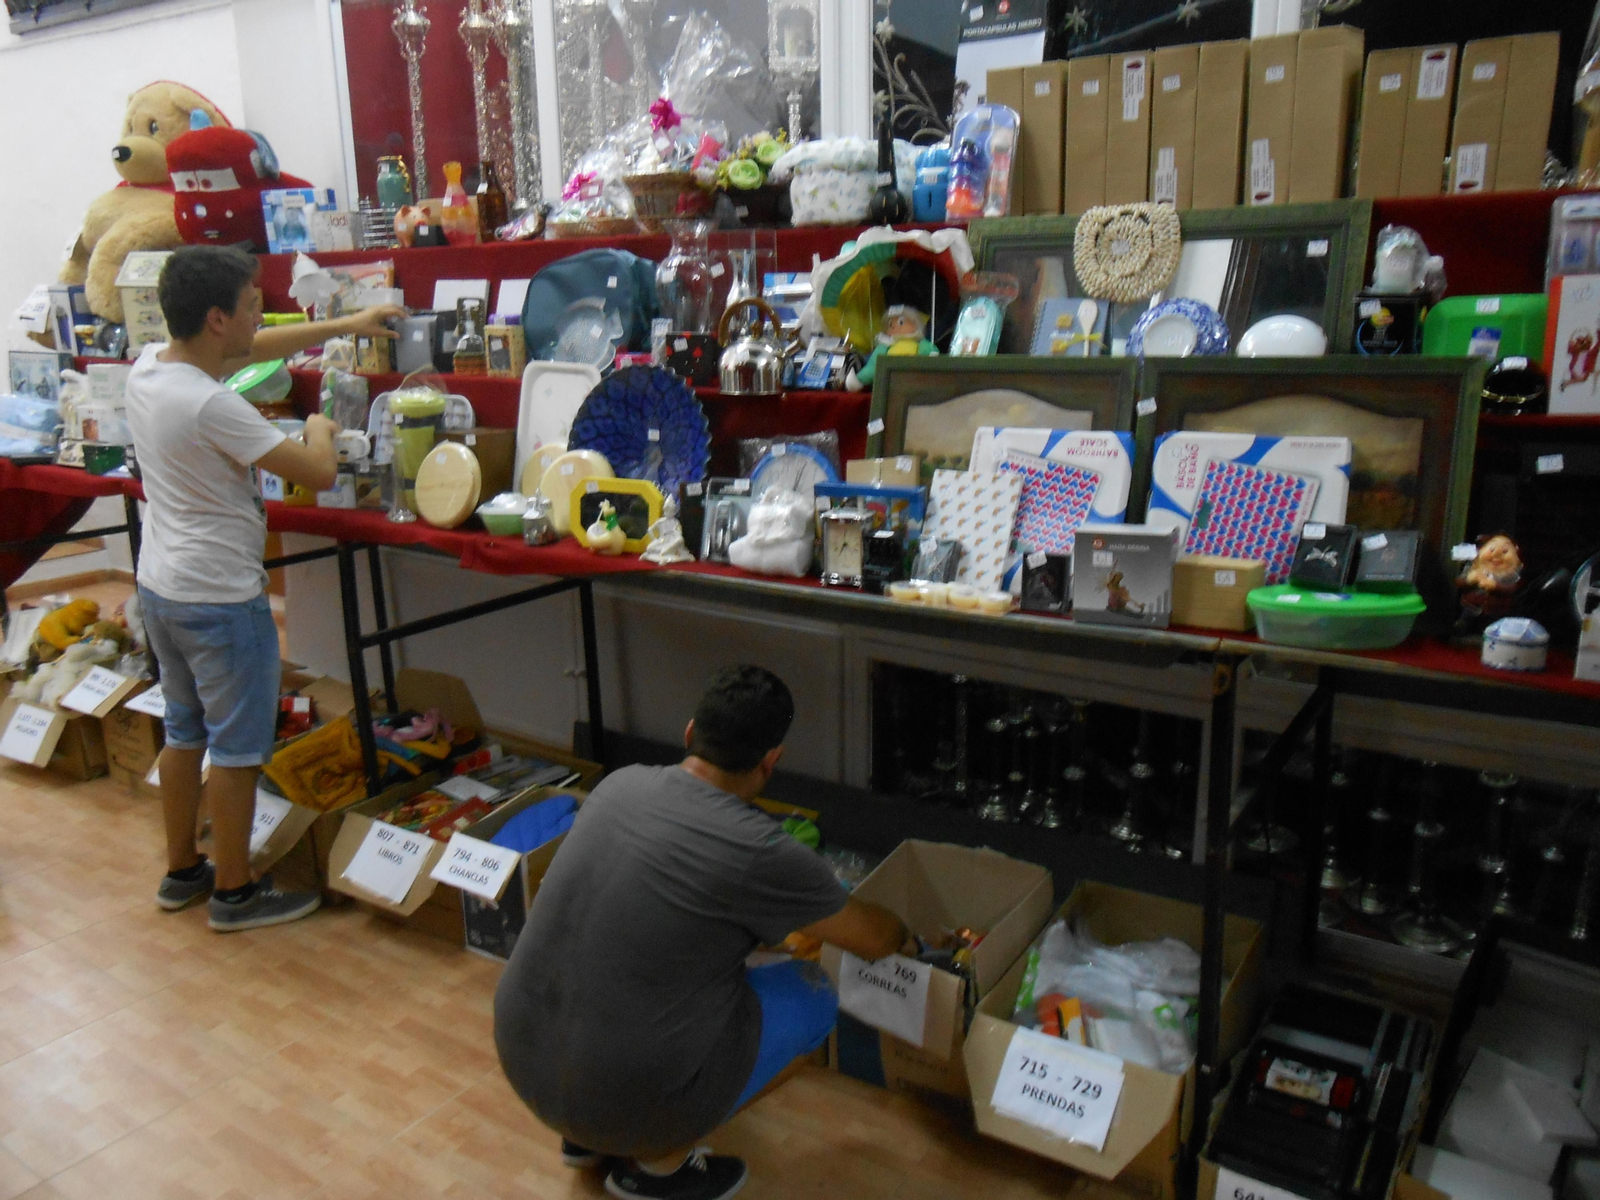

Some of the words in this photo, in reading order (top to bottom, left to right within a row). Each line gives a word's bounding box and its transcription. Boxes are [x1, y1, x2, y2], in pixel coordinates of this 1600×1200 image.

[1067, 447, 1119, 458] BATHROOM
[1079, 438, 1108, 446] SCALE
[258, 813, 275, 827] 911
[376, 828, 393, 842] 807
[403, 840, 420, 855] 871
[378, 847, 404, 866] LIBROS
[454, 848, 472, 863] 794
[481, 856, 501, 872] 806
[448, 865, 489, 886] CHANCLAS
[858, 968, 907, 999] CORREAS
[893, 962, 917, 984] 769
[1019, 1056, 1049, 1079] 715
[1071, 1076, 1102, 1099] 729
[1021, 1083, 1086, 1119] PRENDAS
